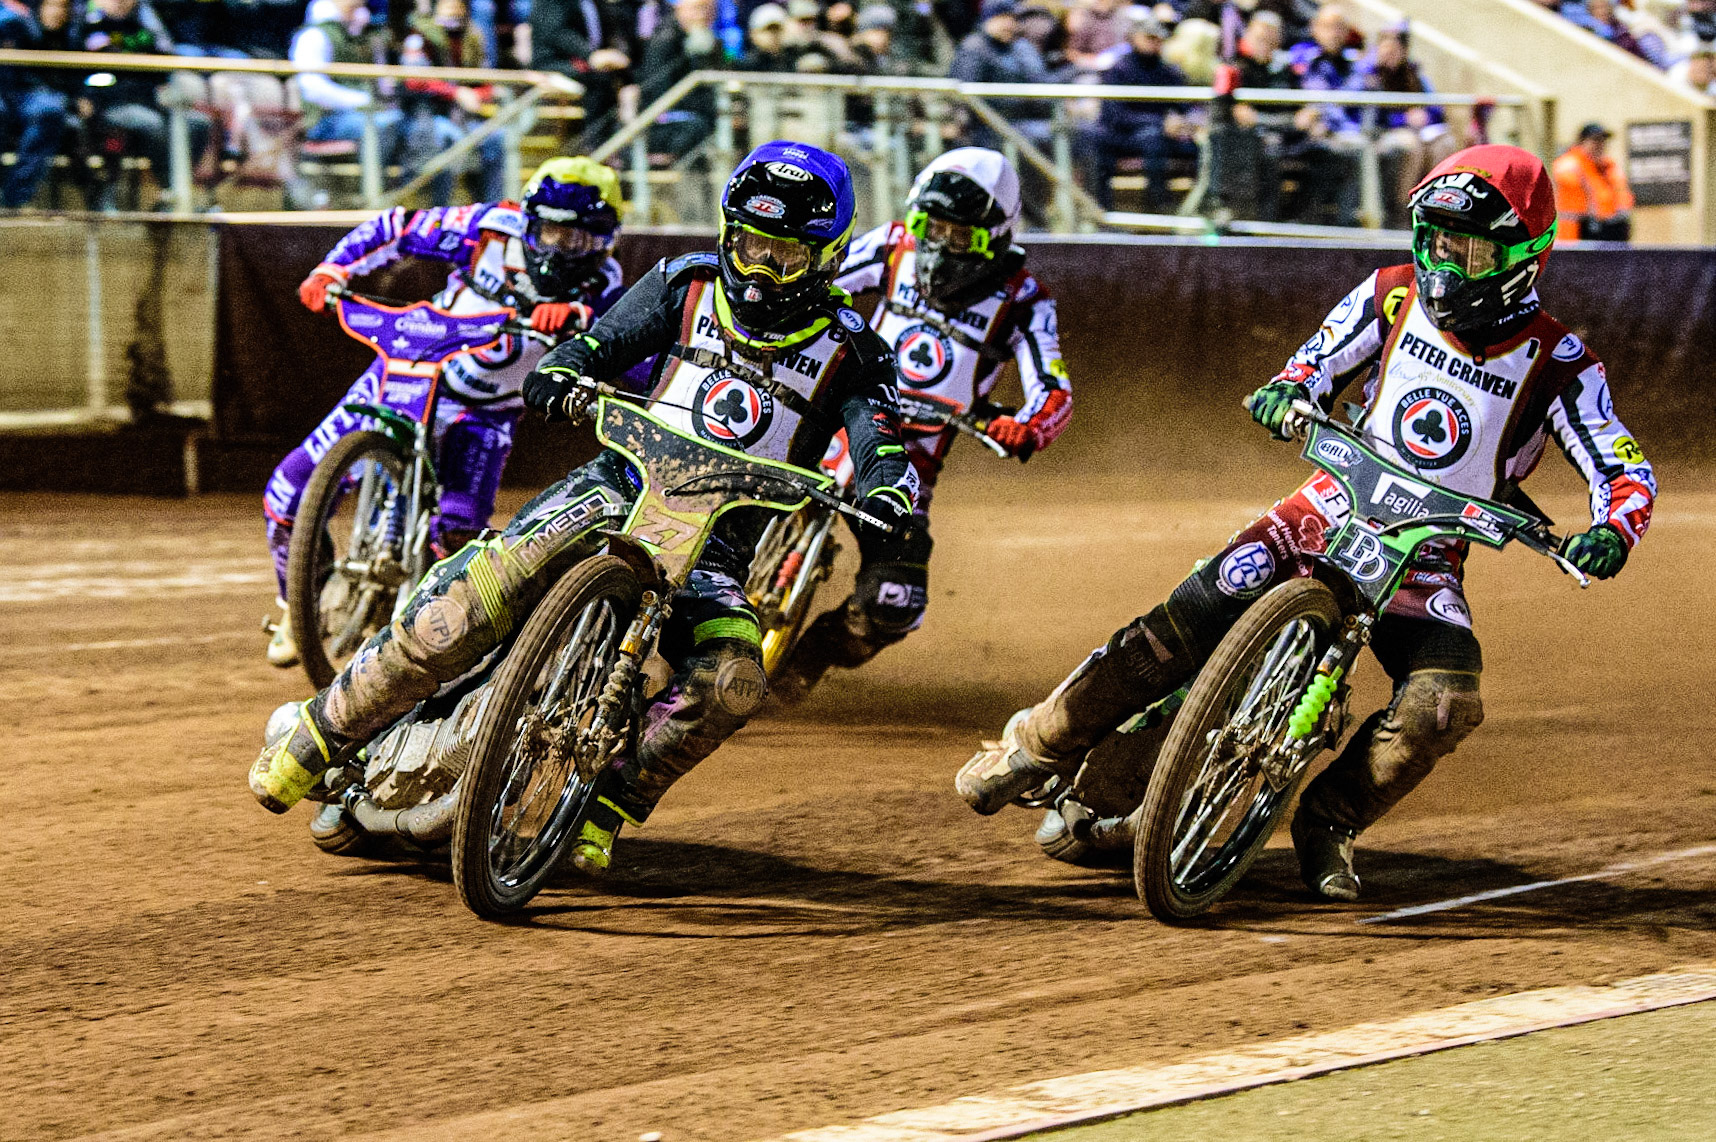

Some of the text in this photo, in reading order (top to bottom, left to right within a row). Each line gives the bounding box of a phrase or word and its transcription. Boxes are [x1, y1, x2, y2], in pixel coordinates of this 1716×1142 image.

[775, 164, 806, 180] Arai
[702, 370, 731, 391] BELLE
[1400, 332, 1518, 399] PETER CRAVEN
[1401, 389, 1470, 435] BELLE VUE ACES
[1384, 492, 1430, 519] agilia
[1267, 525, 1289, 560] Tankers
